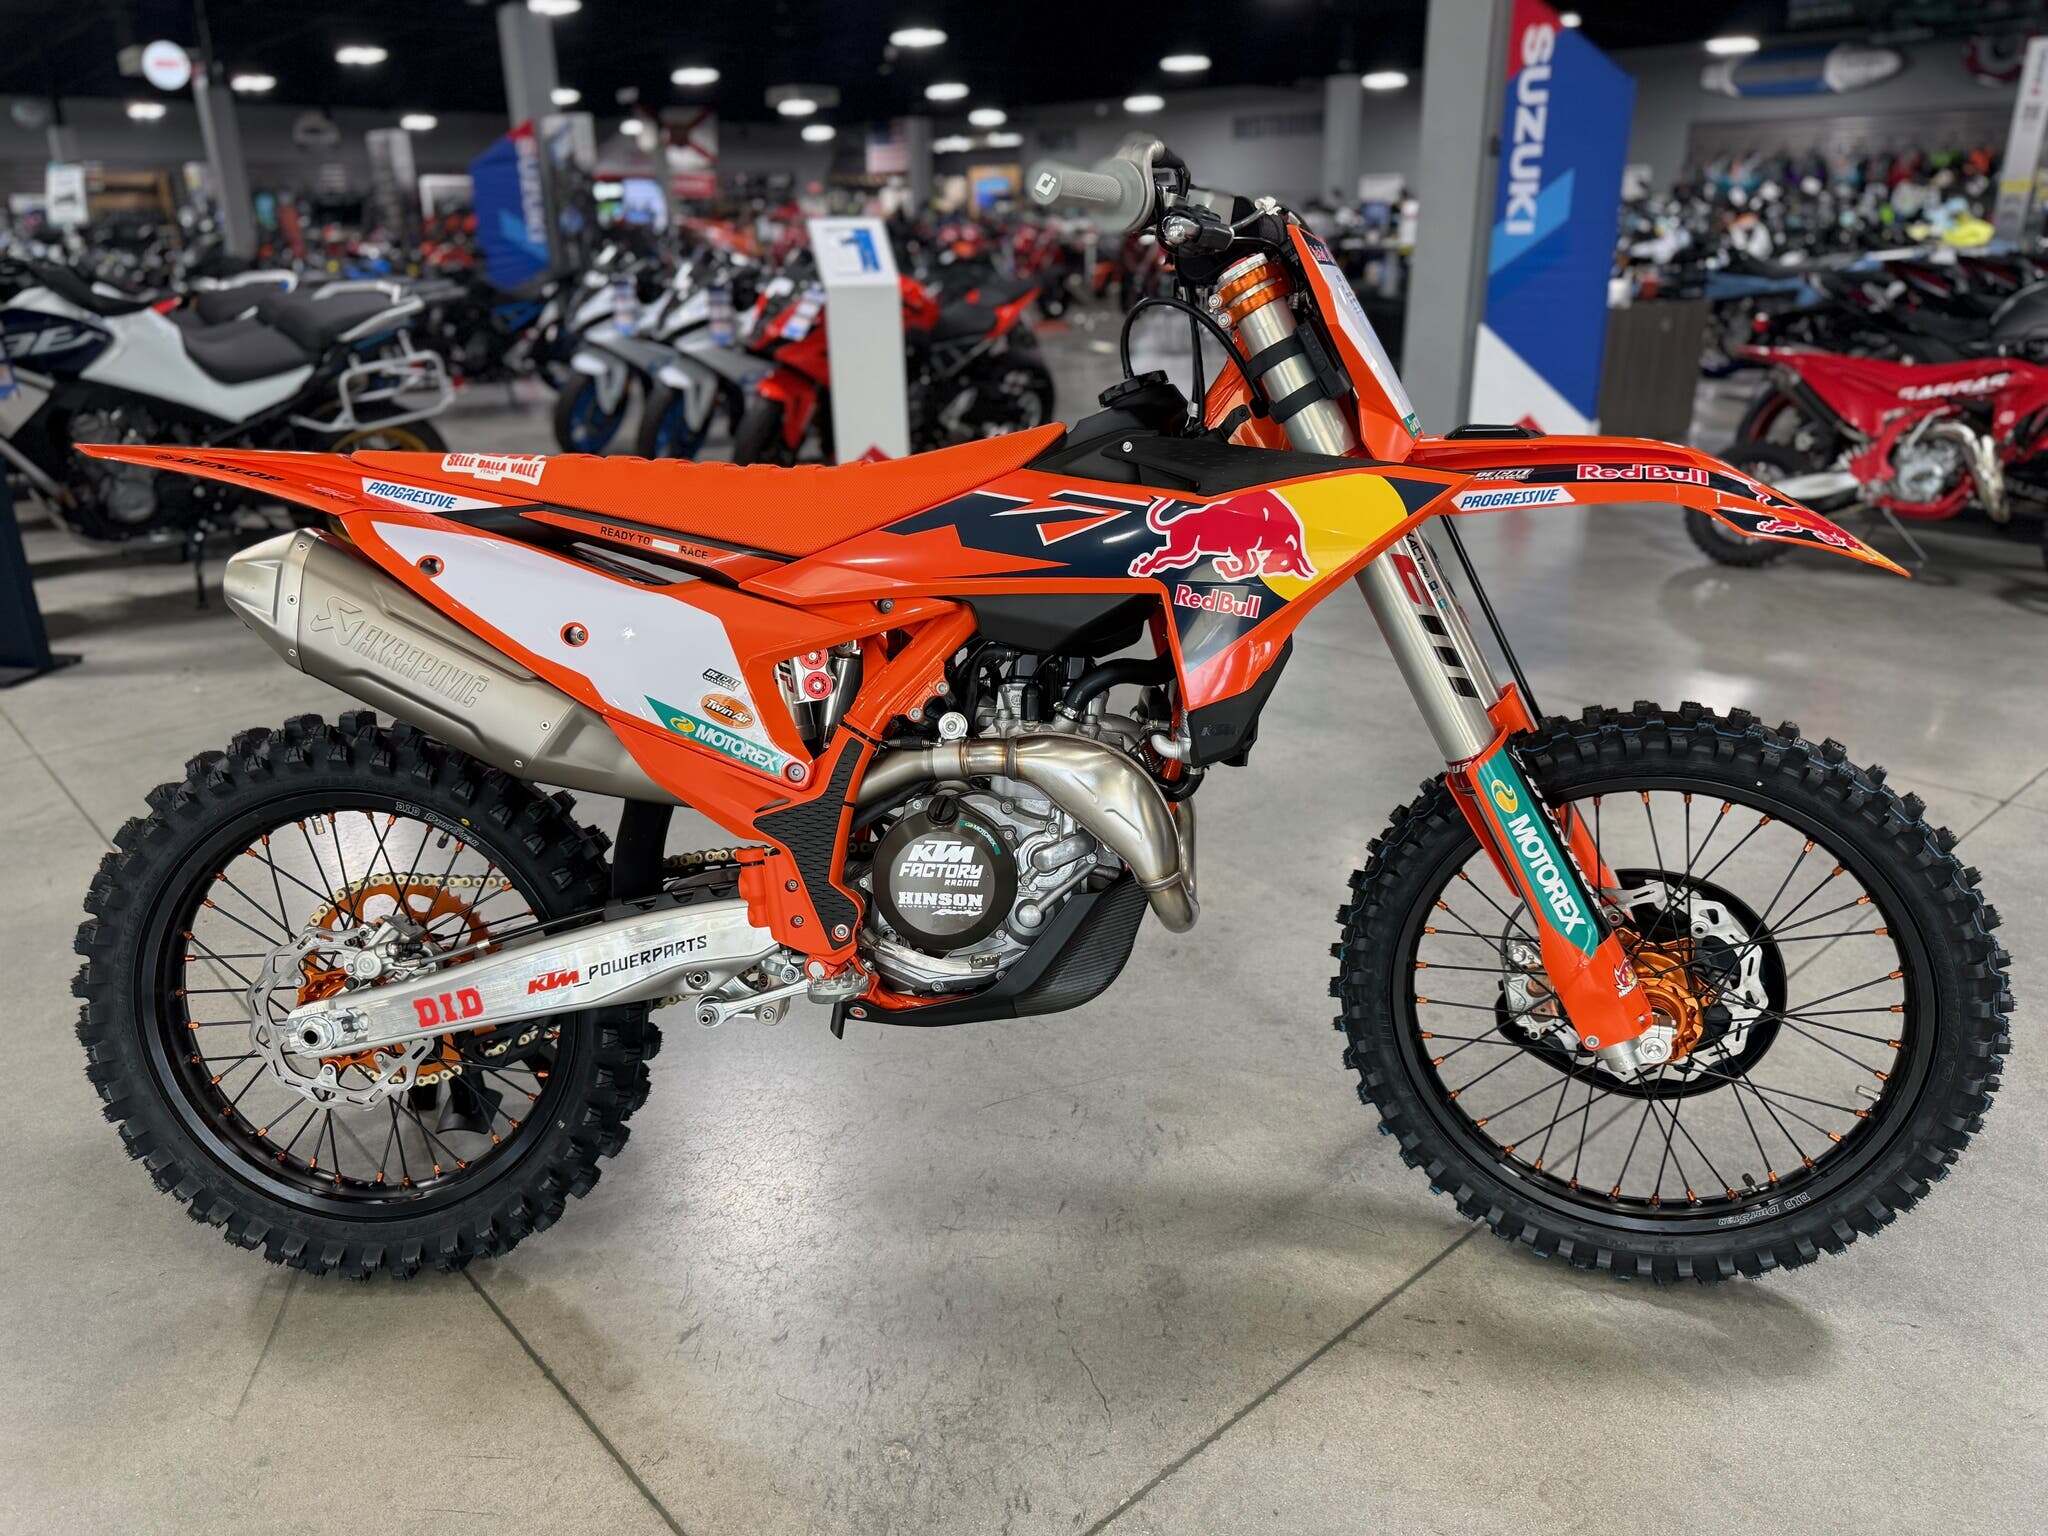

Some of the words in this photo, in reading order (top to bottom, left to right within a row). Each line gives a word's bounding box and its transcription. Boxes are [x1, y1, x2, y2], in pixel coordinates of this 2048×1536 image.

[1505, 23, 1555, 235] SUZUKI
[447, 453, 475, 468] SELLE
[477, 458, 508, 473] DALLA
[510, 461, 540, 478] VALLE
[366, 481, 458, 509] PROGRESSIVE
[1460, 487, 1561, 509] PROGRESSIVE
[600, 526, 635, 542] READY
[637, 534, 651, 546] TO
[680, 545, 709, 560] RACE
[704, 698, 734, 719] Twin
[732, 711, 752, 725] Air
[694, 723, 778, 772] MOTOREX
[907, 840, 976, 864] KTM
[898, 862, 985, 880] FACTORY
[944, 879, 980, 888] RACING
[1507, 813, 1586, 936] MOTOREX
[898, 891, 984, 907] HINSON
[527, 968, 580, 996] KTM
